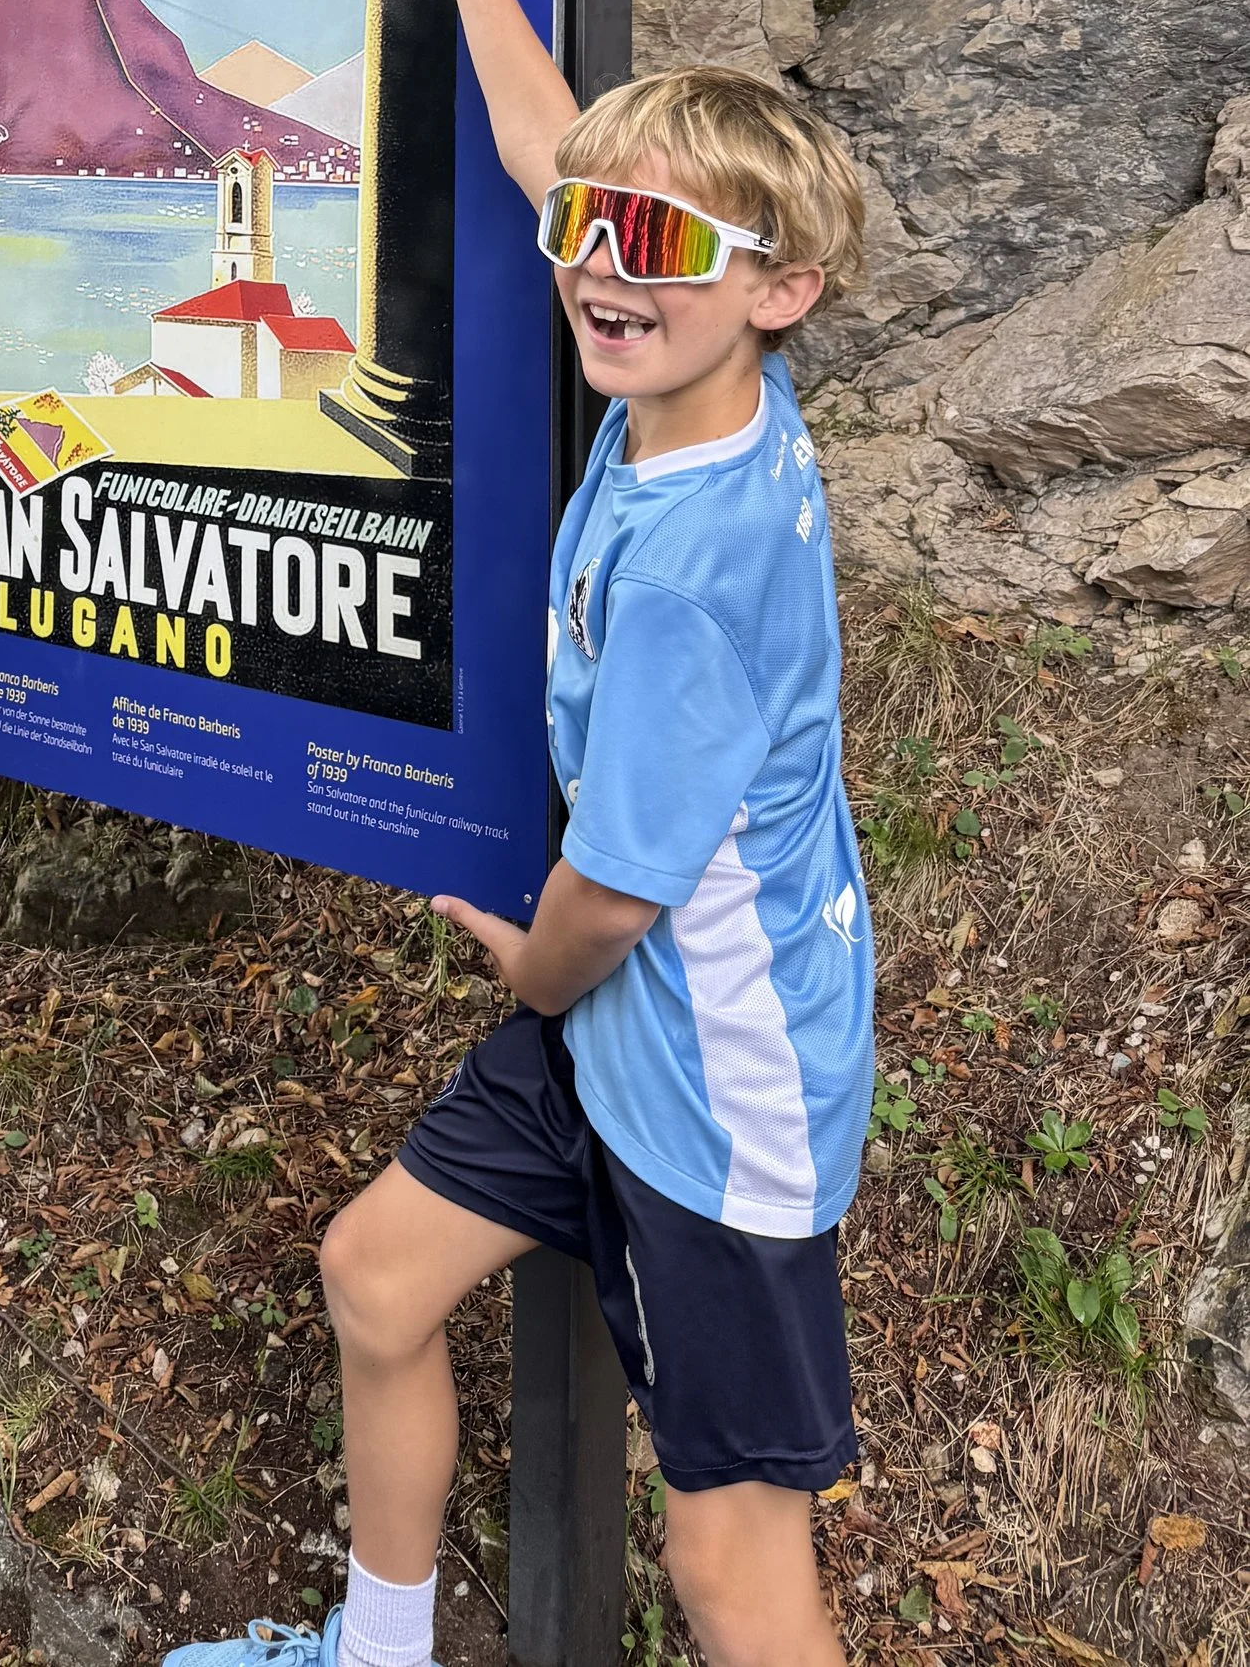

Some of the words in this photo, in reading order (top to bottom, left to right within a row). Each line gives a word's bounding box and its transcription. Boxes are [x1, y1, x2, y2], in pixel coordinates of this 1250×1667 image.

[58, 476, 423, 661] SALVATORE
[5, 687, 27, 704] 1939
[22, 675, 60, 696] Barberis
[2, 705, 16, 717] von
[16, 708, 28, 721] der
[28, 711, 51, 727] Sonne
[51, 716, 87, 737] bestrahlte
[112, 695, 147, 717] Affiche
[148, 704, 161, 720] de
[162, 707, 196, 729] Franco
[198, 715, 241, 739] Barberis
[112, 713, 125, 729] de
[126, 716, 150, 735] 1939
[1, 721, 13, 735] die
[13, 724, 31, 739] Linie
[30, 729, 42, 742] der
[42, 732, 93, 755] Standseilbahn
[111, 732, 130, 747] Avec
[131, 736, 139, 750] le
[139, 739, 155, 754] San
[155, 743, 192, 763] Salvatore
[193, 752, 219, 770] irradié
[219, 759, 231, 773] de
[231, 763, 253, 778] soleil
[254, 768, 264, 782] et
[265, 770, 274, 783] le
[111, 750, 132, 766] tracé
[132, 755, 143, 769] du
[143, 757, 184, 779] funiculaire
[307, 741, 344, 764] Poster
[346, 749, 361, 771] by
[362, 754, 402, 777] Franco
[404, 764, 454, 790] Barberis
[307, 761, 321, 780] of
[321, 764, 348, 783] 1939
[307, 780, 324, 796] San
[325, 785, 368, 807] Salvatore
[369, 797, 387, 812] and
[388, 800, 404, 816] the
[405, 804, 447, 826] funicular
[448, 817, 483, 837] railway
[484, 824, 509, 841] track
[307, 800, 333, 817] stand
[333, 807, 350, 822] out
[350, 810, 360, 824] in
[361, 812, 377, 828] the
[378, 819, 420, 839] sunshine
